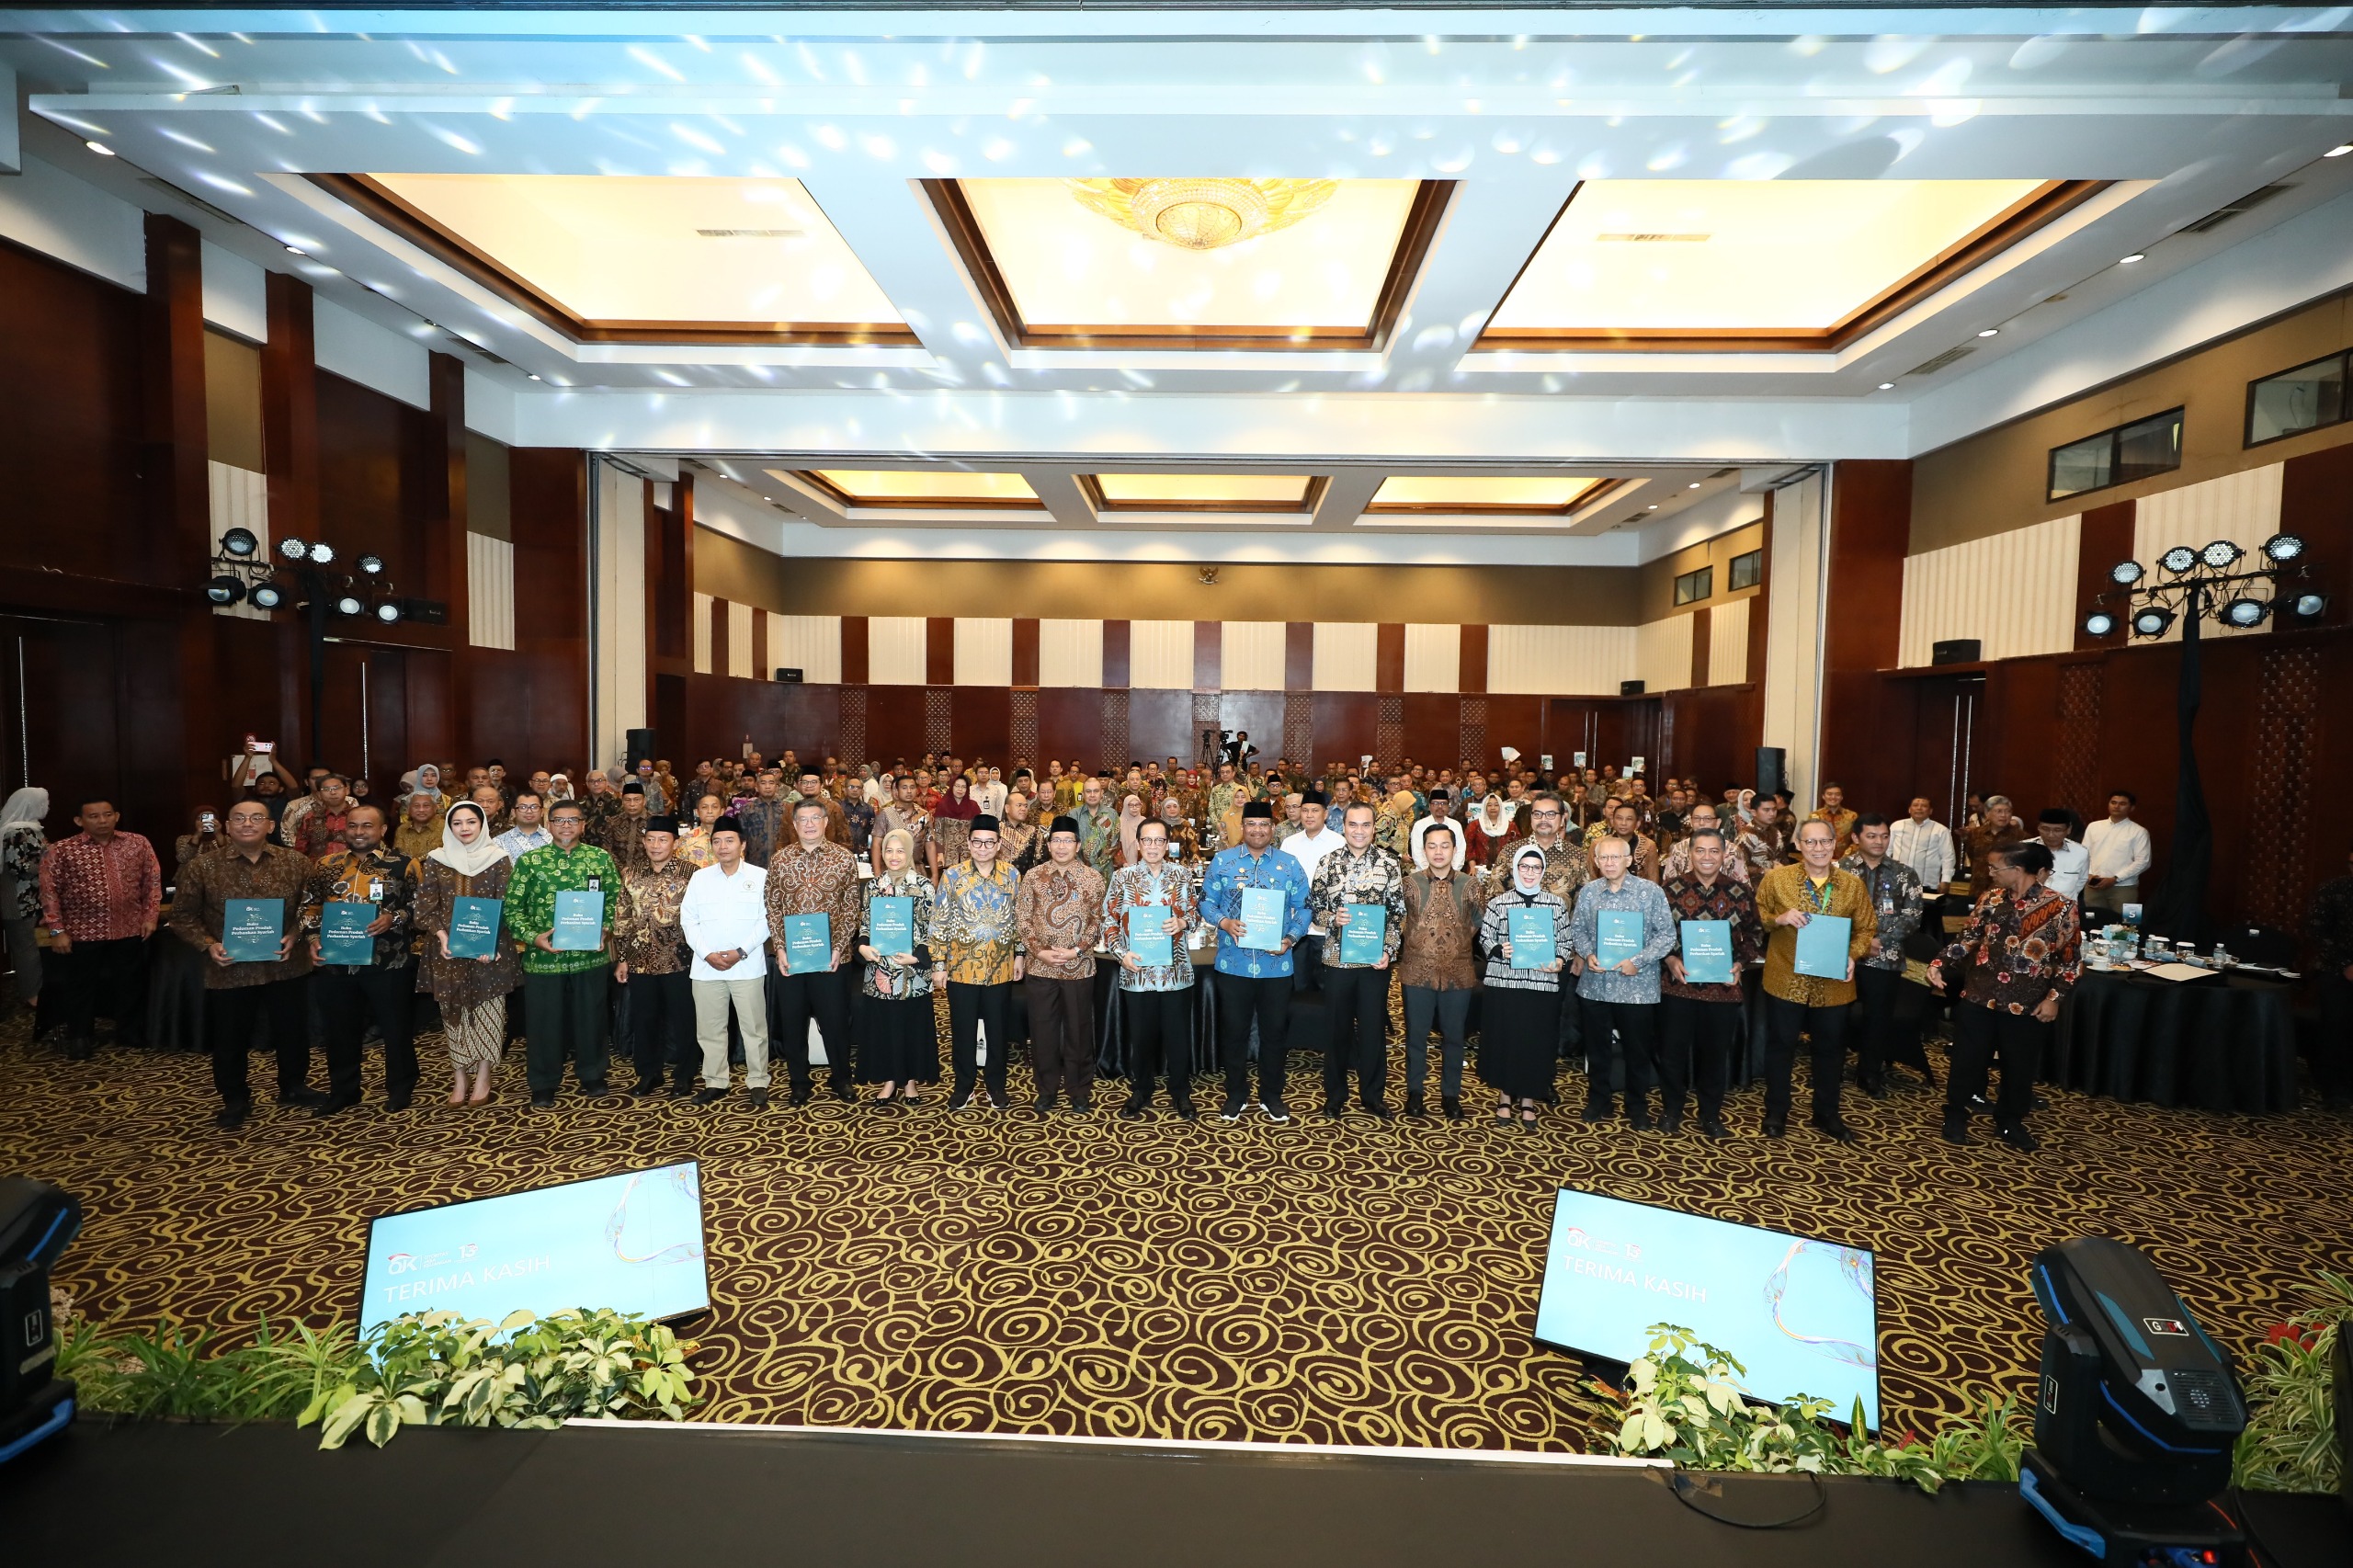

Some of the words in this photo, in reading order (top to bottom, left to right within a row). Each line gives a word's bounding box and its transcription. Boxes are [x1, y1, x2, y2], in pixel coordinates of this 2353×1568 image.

[383, 1271, 475, 1303] TERIMA
[483, 1254, 551, 1283] KASIH
[1563, 1255, 1637, 1288] TERIMA
[1643, 1273, 1707, 1303] KASIH
